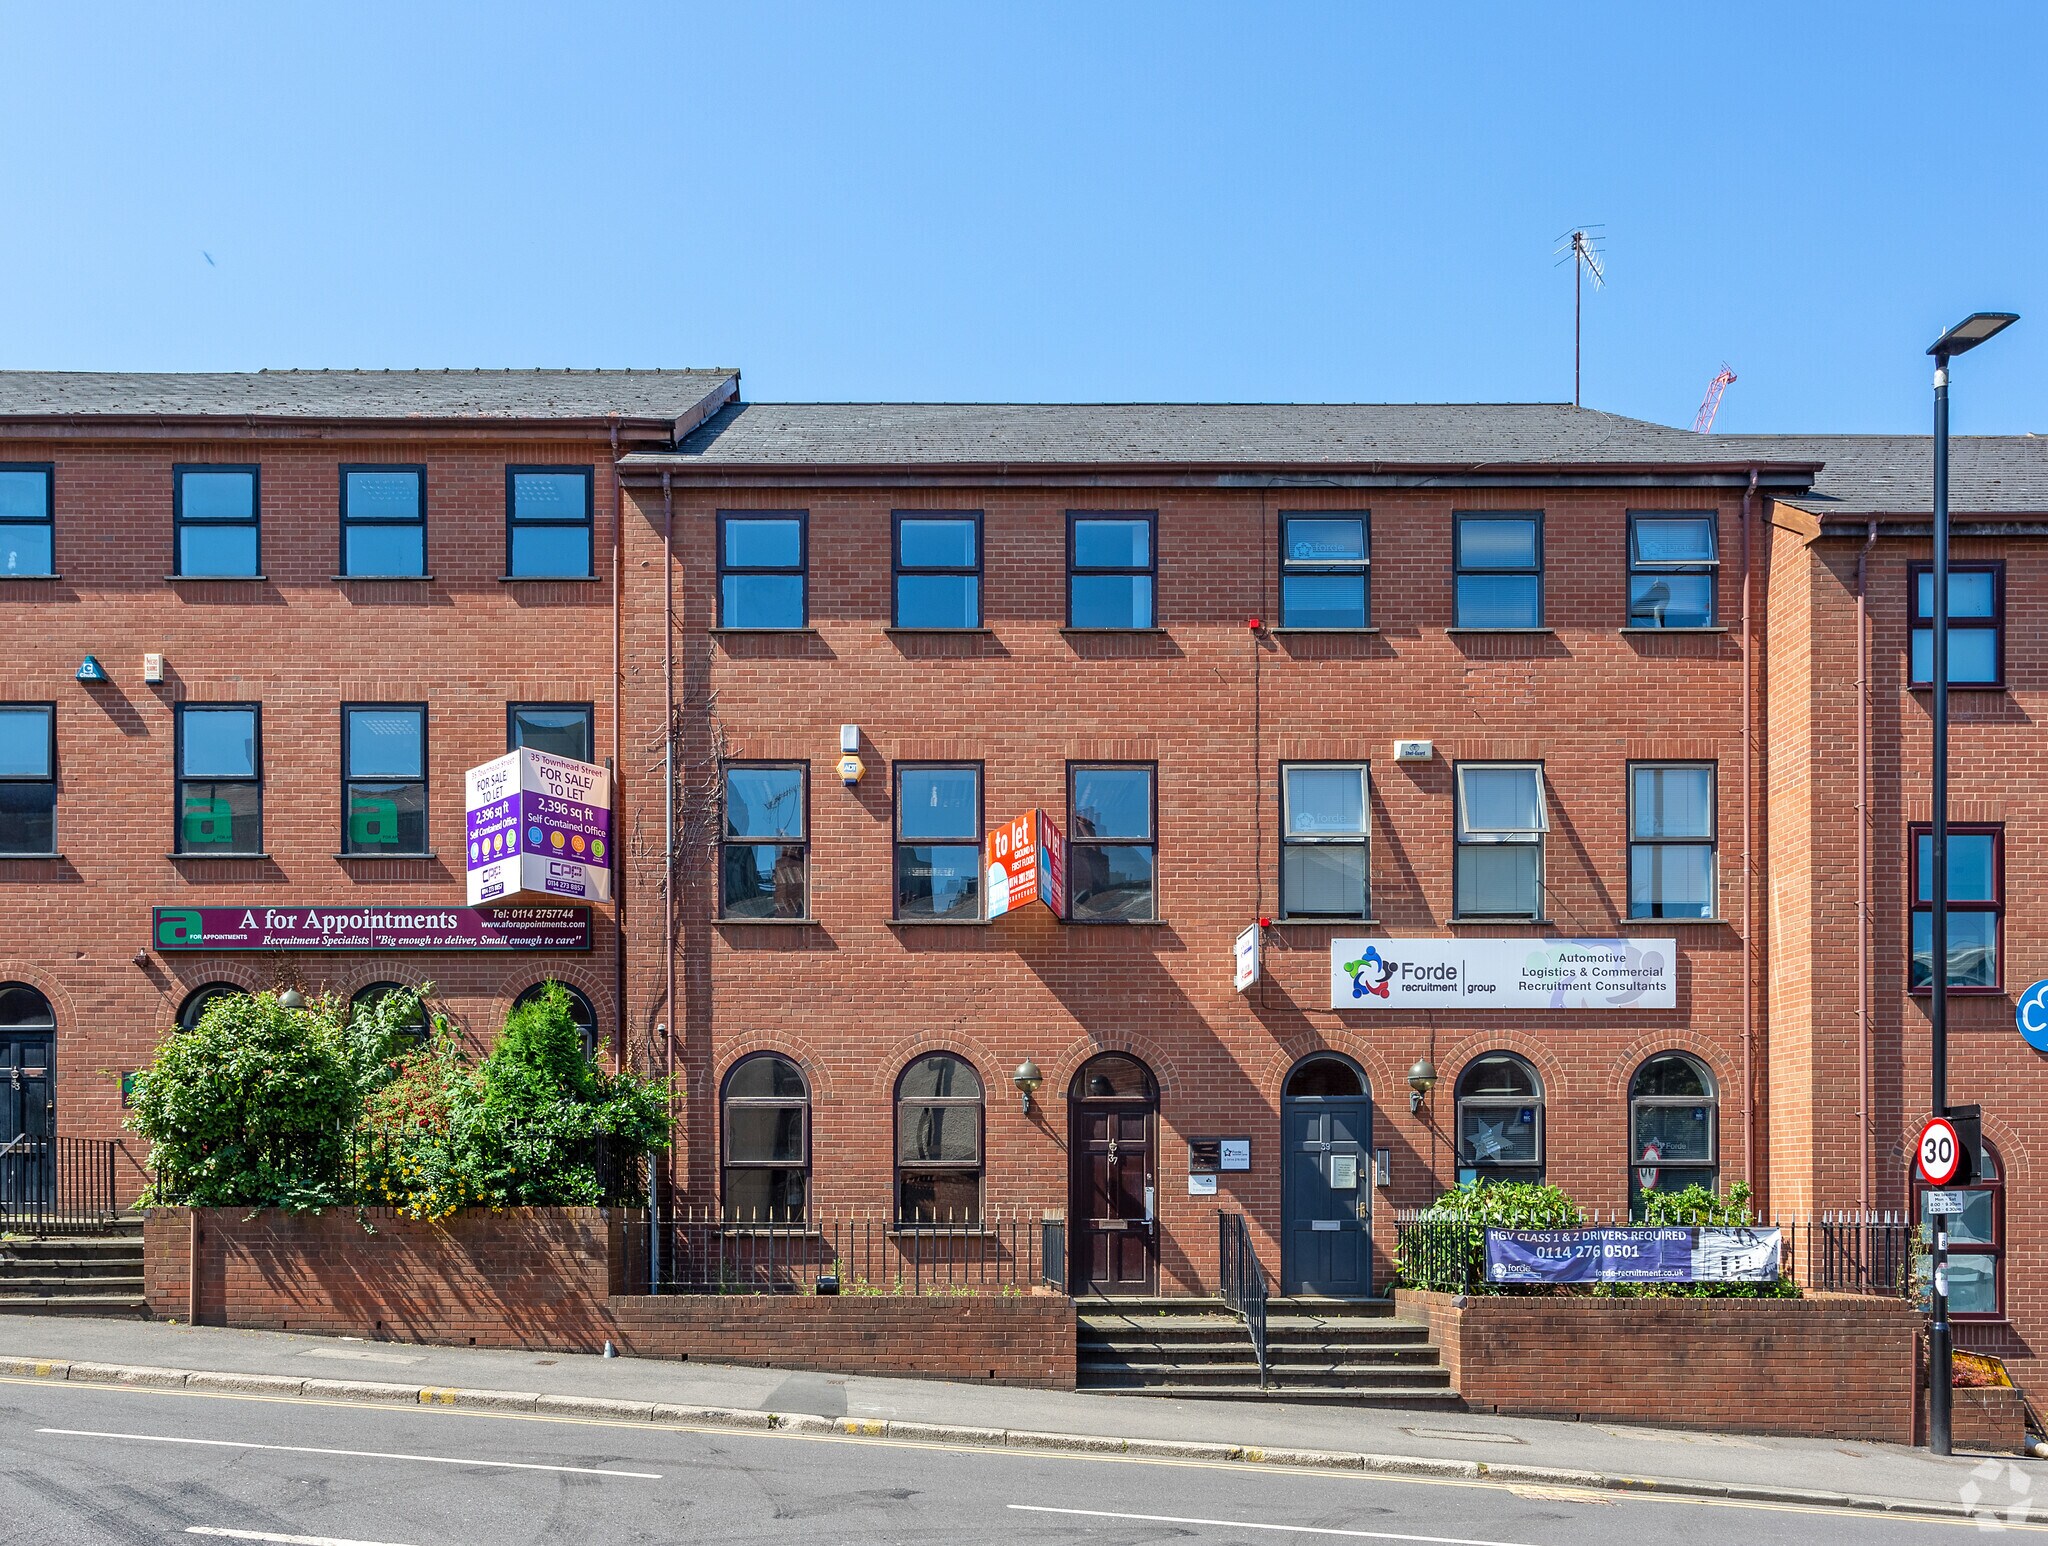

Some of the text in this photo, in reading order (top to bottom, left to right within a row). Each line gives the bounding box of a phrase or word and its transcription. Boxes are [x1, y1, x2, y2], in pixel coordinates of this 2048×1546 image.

[530, 753, 602, 777] 35 Townhead Street
[540, 767, 561, 782] FOR
[477, 778, 489, 791] FOR
[483, 786, 503, 803] TO LET
[549, 783, 584, 801] TO LET
[476, 801, 509, 824] 2,396 sq ft
[538, 798, 593, 821] 2,396 sq ft
[528, 813, 606, 838] Self Contained Office
[995, 817, 1028, 858] to let
[1044, 818, 1051, 849] to
[1052, 826, 1060, 859] let
[493, 909, 574, 918] Tel: 0114 2757744
[239, 909, 458, 934] A for Appointments
[481, 921, 585, 929] www.aforappointments.com
[263, 935, 320, 945] Recruitment
[322, 935, 369, 946] Specialists
[375, 935, 396, 947] "Big
[399, 935, 432, 946] enough
[445, 935, 477, 946] deliver,
[480, 935, 508, 945] Small
[509, 936, 541, 946] enough
[556, 935, 582, 944] care"
[1559, 953, 1626, 963] Automotive
[1402, 962, 1457, 980] Forde
[1522, 967, 1663, 978] Logistics & Commercial
[1402, 983, 1496, 994] recruitment group
[1518, 981, 1667, 991] Recruitment Consultants
[1925, 1137, 1952, 1163] 30
[1108, 1153, 1118, 1165] 37
[1490, 1231, 1686, 1243] HGV CLASS 1 & 2 DRIVERS REQUIRED
[1536, 1245, 1639, 1259] 0114 276 0501
[1508, 1264, 1531, 1272] forde
[1596, 1268, 1684, 1277] forde-recruitment.co.uk
